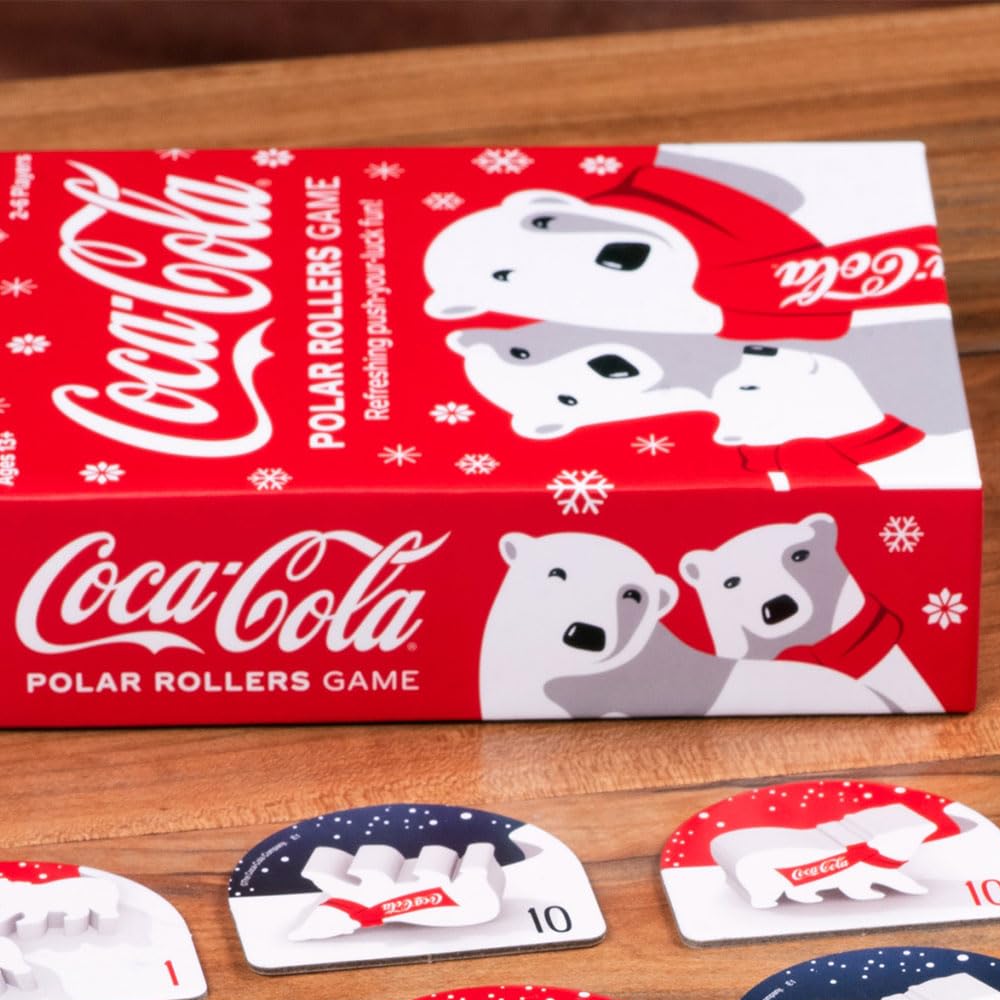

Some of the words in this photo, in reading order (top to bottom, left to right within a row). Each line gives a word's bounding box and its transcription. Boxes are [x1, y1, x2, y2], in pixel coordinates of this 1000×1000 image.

[9, 153, 36, 196] Players
[8, 197, 30, 221] 2-6
[304, 176, 341, 241] GAME
[358, 198, 384, 227] fun!
[359, 228, 392, 335] push-your-luck
[52, 160, 275, 458] Coca-Cola
[306, 245, 344, 361] ROLLERS
[363, 337, 394, 421] Refreshing
[308, 363, 346, 449] POLAR
[0, 454, 20, 487] Ages
[15, 530, 451, 655] Coca-Cola
[26, 672, 141, 694] POLAR
[154, 671, 310, 693] ROLLERS
[323, 670, 421, 692] GAME
[791, 855, 850, 880] Coca-Cola
[381, 892, 443, 914] Coca-Cola
[526, 905, 573, 934] 10
[165, 960, 179, 986] 1
